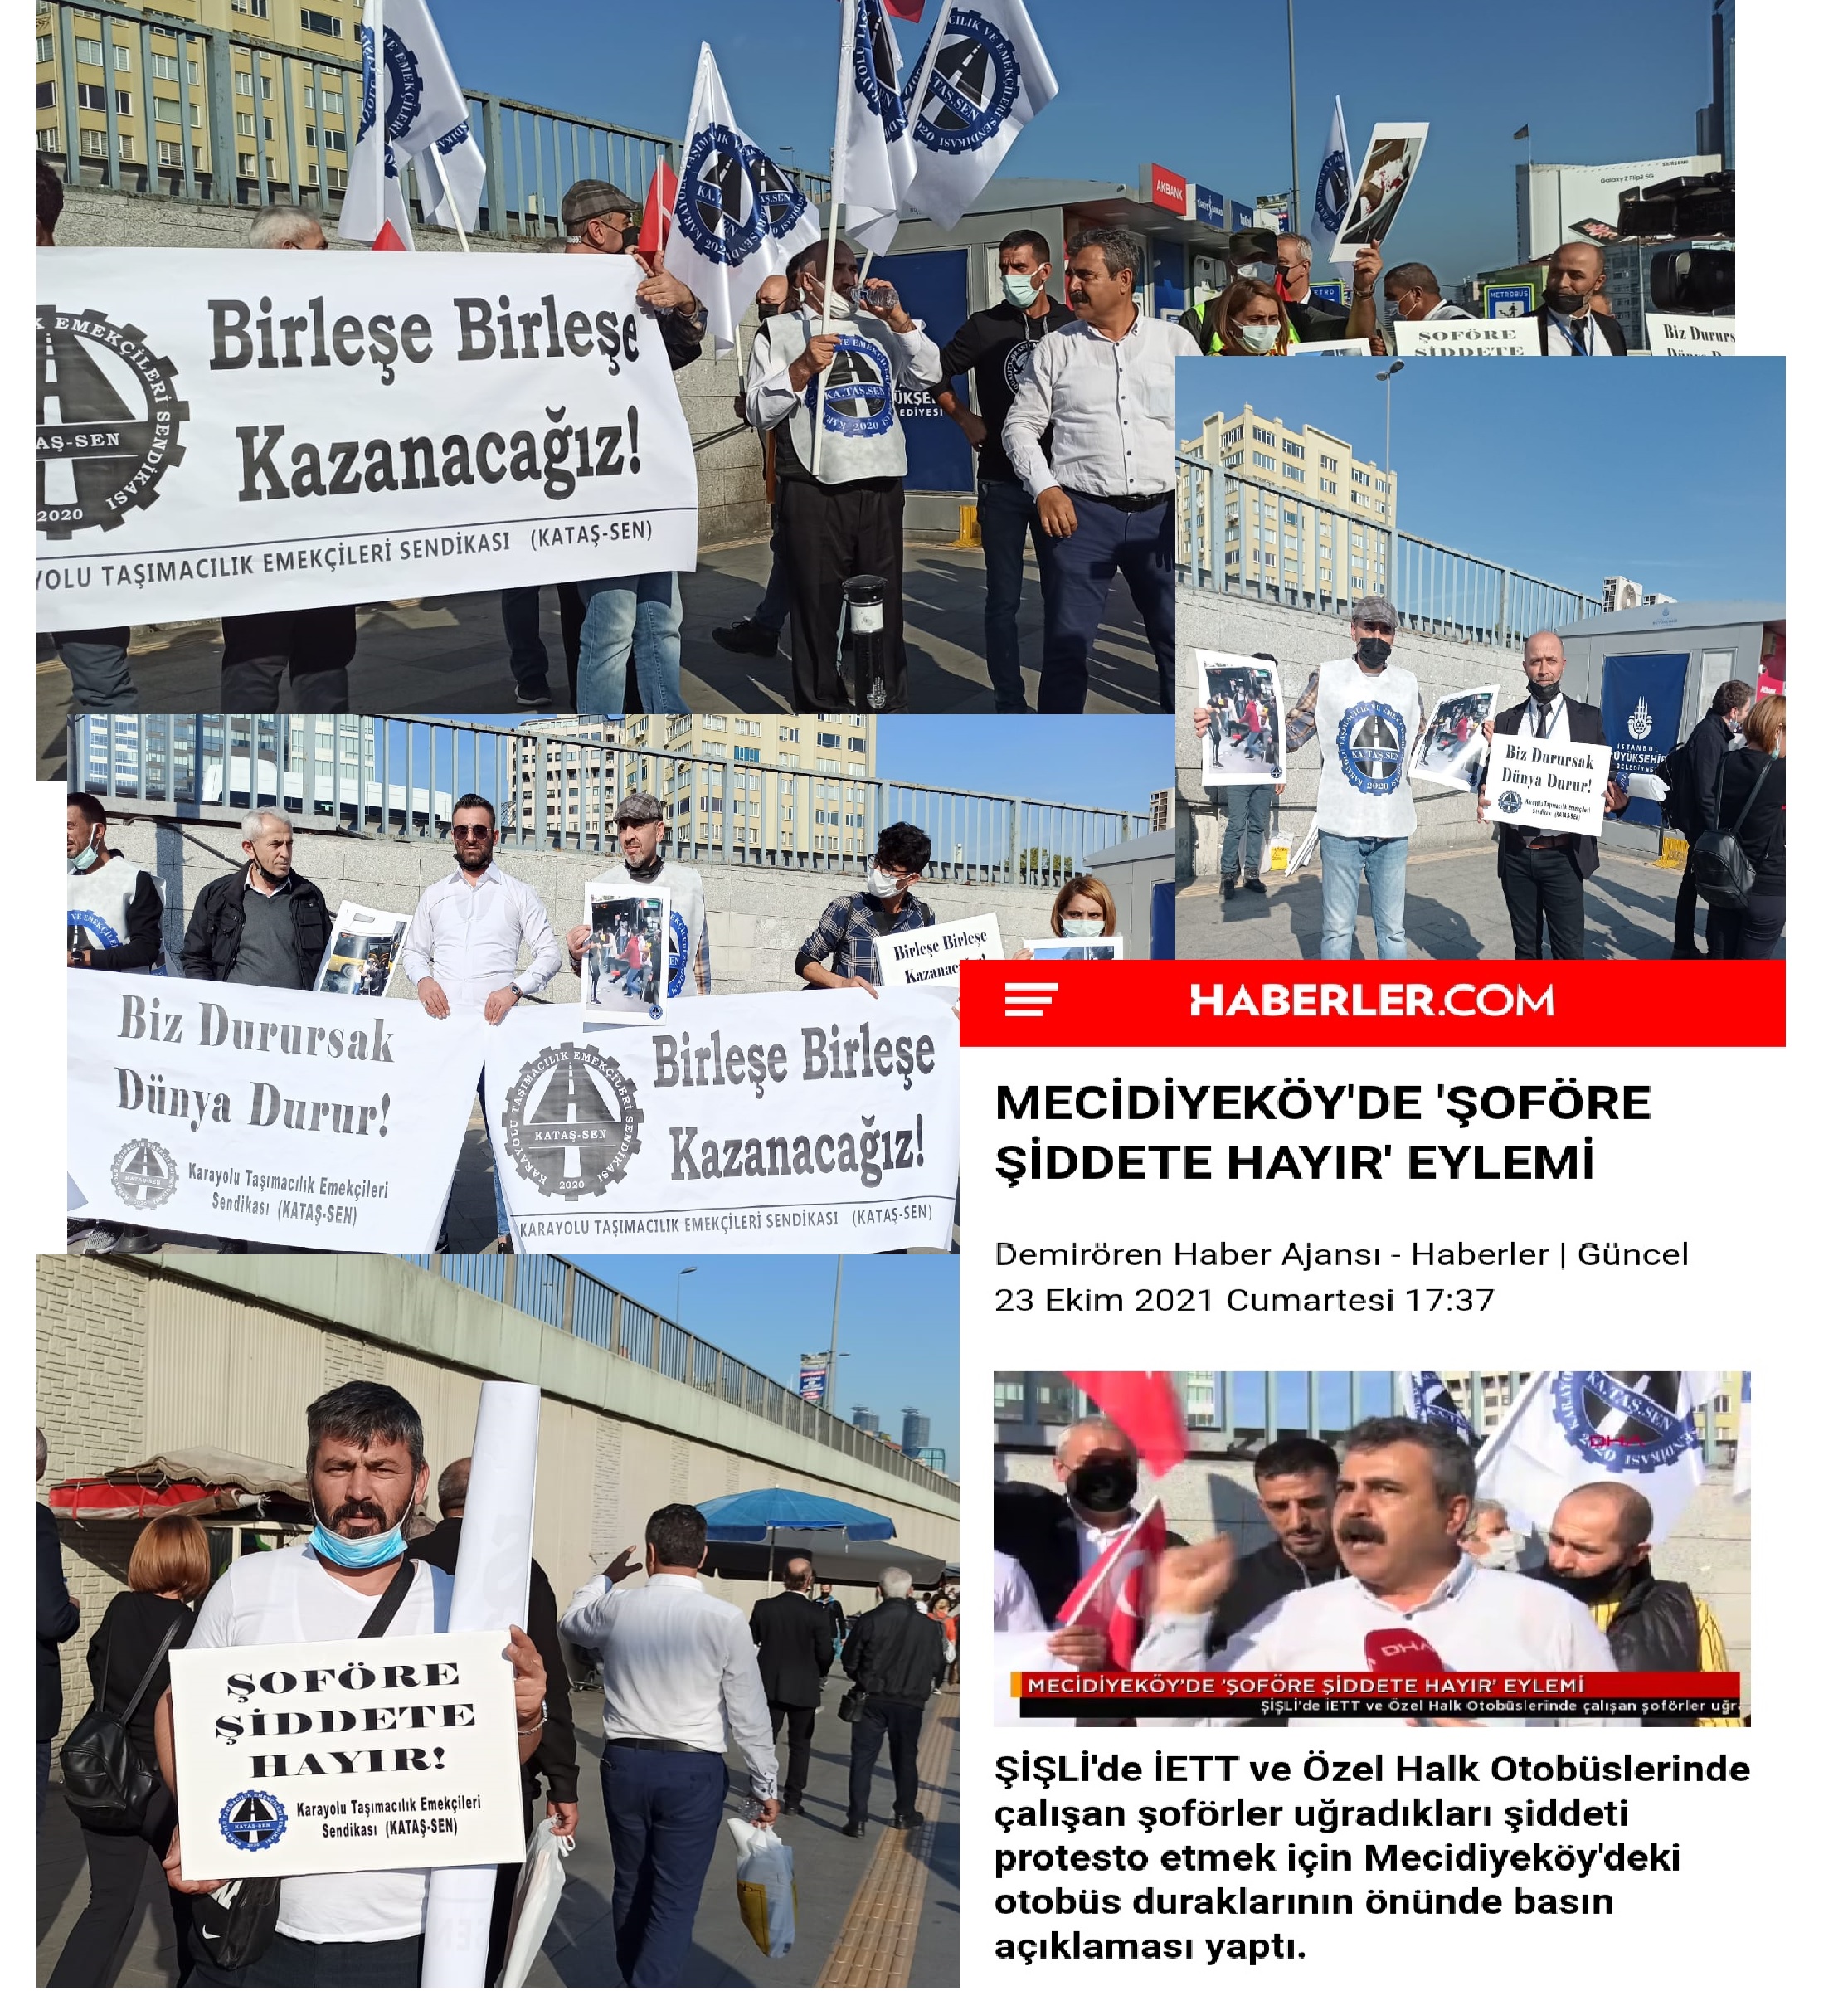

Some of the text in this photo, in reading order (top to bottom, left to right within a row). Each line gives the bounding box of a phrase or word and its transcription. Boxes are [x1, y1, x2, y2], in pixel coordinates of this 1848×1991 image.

[985, 27, 998, 43] VE
[995, 42, 1015, 119] EMEKÇİLERİ
[928, 72, 980, 122] .TAŞ.SEN
[939, 117, 998, 148] SENDİKASI
[1156, 179, 1183, 202] AKBANK
[1601, 175, 1623, 184] Galaxy
[1629, 174, 1644, 183] Flip3
[1491, 290, 1529, 299] METROBÜS
[207, 294, 639, 386] Birleşe Birleşe
[1418, 329, 1516, 344] ŞOFÖRE
[1663, 324, 1686, 339] Biz
[1690, 325, 1735, 343] Dururs
[55, 316, 172, 511] EMEKÇİLERİ SENDİKASI
[853, 422, 879, 431] 2020
[36, 433, 120, 452] AŞ-SEN
[236, 405, 640, 502] Kazanacağız!
[36, 509, 84, 522] 2020
[36, 520, 653, 591] YOLU TAŞIMACILIK EMEKÇİLERİ SENDİKASI (KATAŞ-SEN)
[1505, 744, 1593, 770] Biz Durursak
[1617, 742, 1658, 752] İSTANBUL
[1501, 767, 1592, 793] Dünya Durur!
[1616, 762, 1653, 772] BELEDİYES
[894, 929, 988, 961] Birleşe Birleşe
[117, 994, 395, 1063] Biz Durursak
[653, 1022, 936, 1099] Birleşe Birleşe
[115, 1066, 391, 1137] Dünya Durur!
[510, 1051, 634, 1185] KARAYOLU TAŞIMACILIK EMEKÇİLERİ SENDİKASI
[534, 1129, 607, 1142] KATAŞ-SEN
[669, 1113, 925, 1188] Kazanacağız!
[188, 1162, 389, 1200] Karayolu Taşımacılık Emekçileri
[559, 1180, 585, 1189] 2020
[212, 1192, 357, 1228] Sendikası (KATAŞ-SEN)
[520, 1205, 932, 1238] KARAYOLU TAŞIMACILIK EMEKÇİLERİ SENDİKASI (KATAŞ-SEN)
[1381, 1641, 1434, 1657] DHA
[226, 1662, 460, 1703] ŞOFÖRE
[216, 1703, 475, 1745] ŞİDDETE
[249, 1746, 445, 1778] HAYIR!
[296, 1794, 481, 1819] Karayolu Taşımacılık Emekçileri
[322, 1818, 458, 1839] Sendikası (KATAŞ-SEN)
